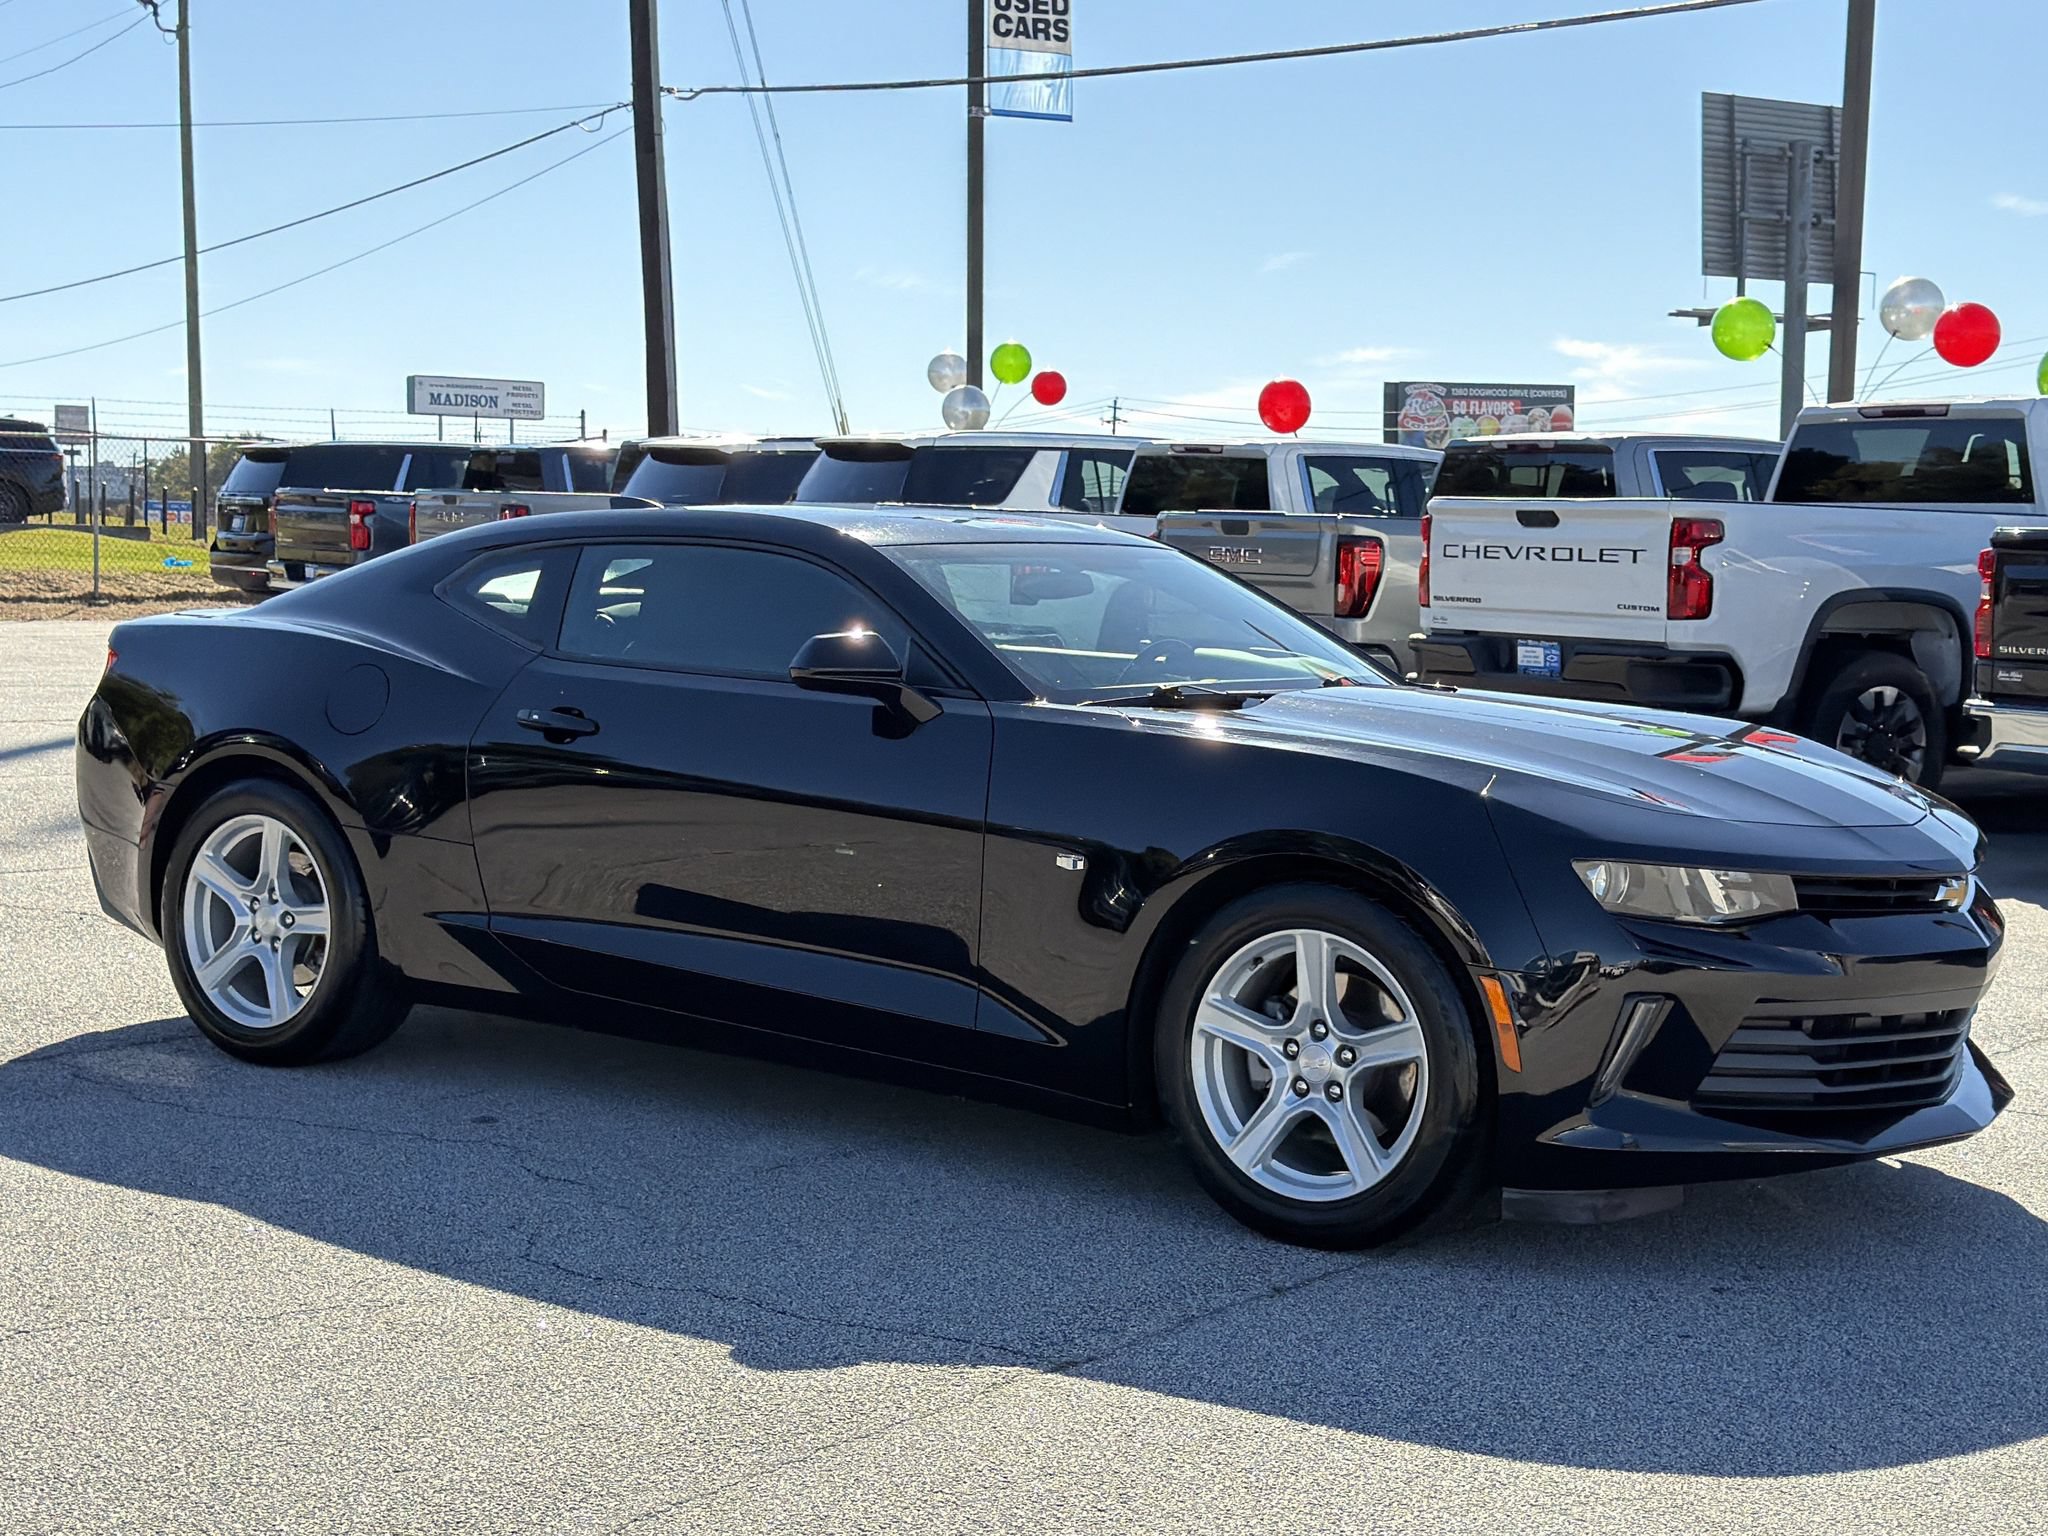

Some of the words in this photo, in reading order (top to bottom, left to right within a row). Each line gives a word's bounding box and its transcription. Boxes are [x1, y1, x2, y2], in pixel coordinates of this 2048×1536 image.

[994, 0, 1069, 16] USED
[993, 13, 1069, 42] CARS
[1469, 388, 1508, 397] DOGWOOD
[1508, 388, 1529, 397] DRIVE
[429, 392, 500, 409] MADISON
[1452, 400, 1467, 415] 60
[1470, 400, 1515, 415] FLAVORS
[1208, 546, 1262, 565] GMC
[1443, 543, 1648, 565] CHEVROLET
[1433, 595, 1482, 604] SILVERADO
[1616, 603, 1661, 612] CUSTOM
[1999, 645, 2048, 655] SILVER
